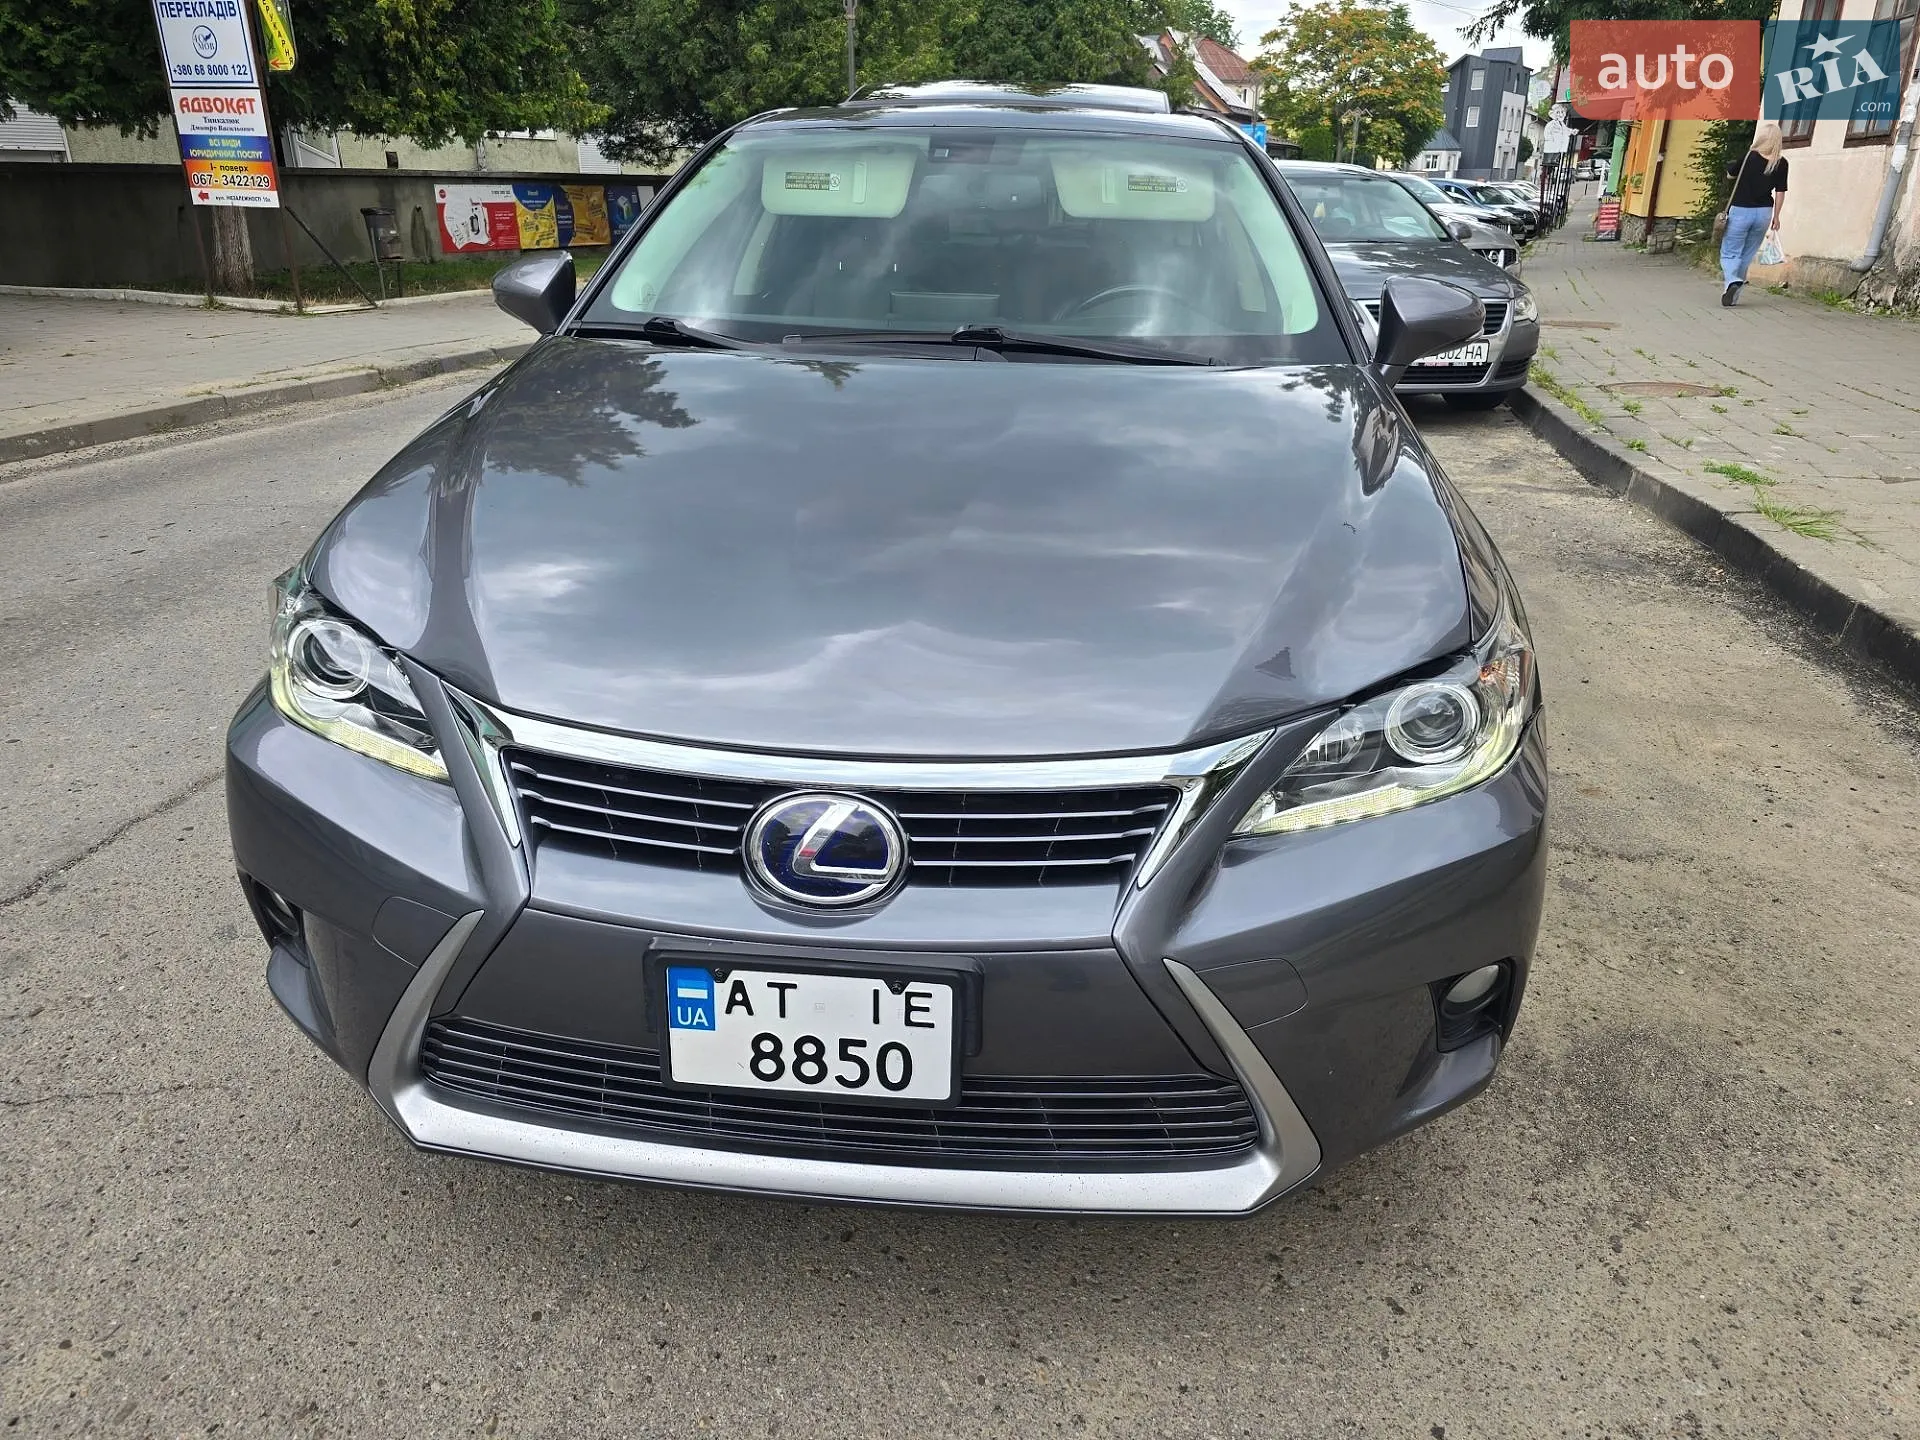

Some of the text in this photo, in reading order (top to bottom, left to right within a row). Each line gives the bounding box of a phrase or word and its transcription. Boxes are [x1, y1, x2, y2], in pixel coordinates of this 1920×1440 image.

[160, 0, 237, 20] ПЕРЕКЛАДІВ
[173, 64, 248, 75] +380 68 8000 122
[179, 97, 256, 115] АДВОКАТ
[208, 139, 241, 148] ВСІ ВИДИ
[190, 149, 263, 159] ЮРИДИЧНИХ ПОСЛУГ
[219, 164, 249, 174] поверх
[223, 174, 270, 188] 3422129
[725, 979, 935, 1029] AT IE
[677, 1006, 709, 1027] UA
[749, 1032, 913, 1091] 8850
